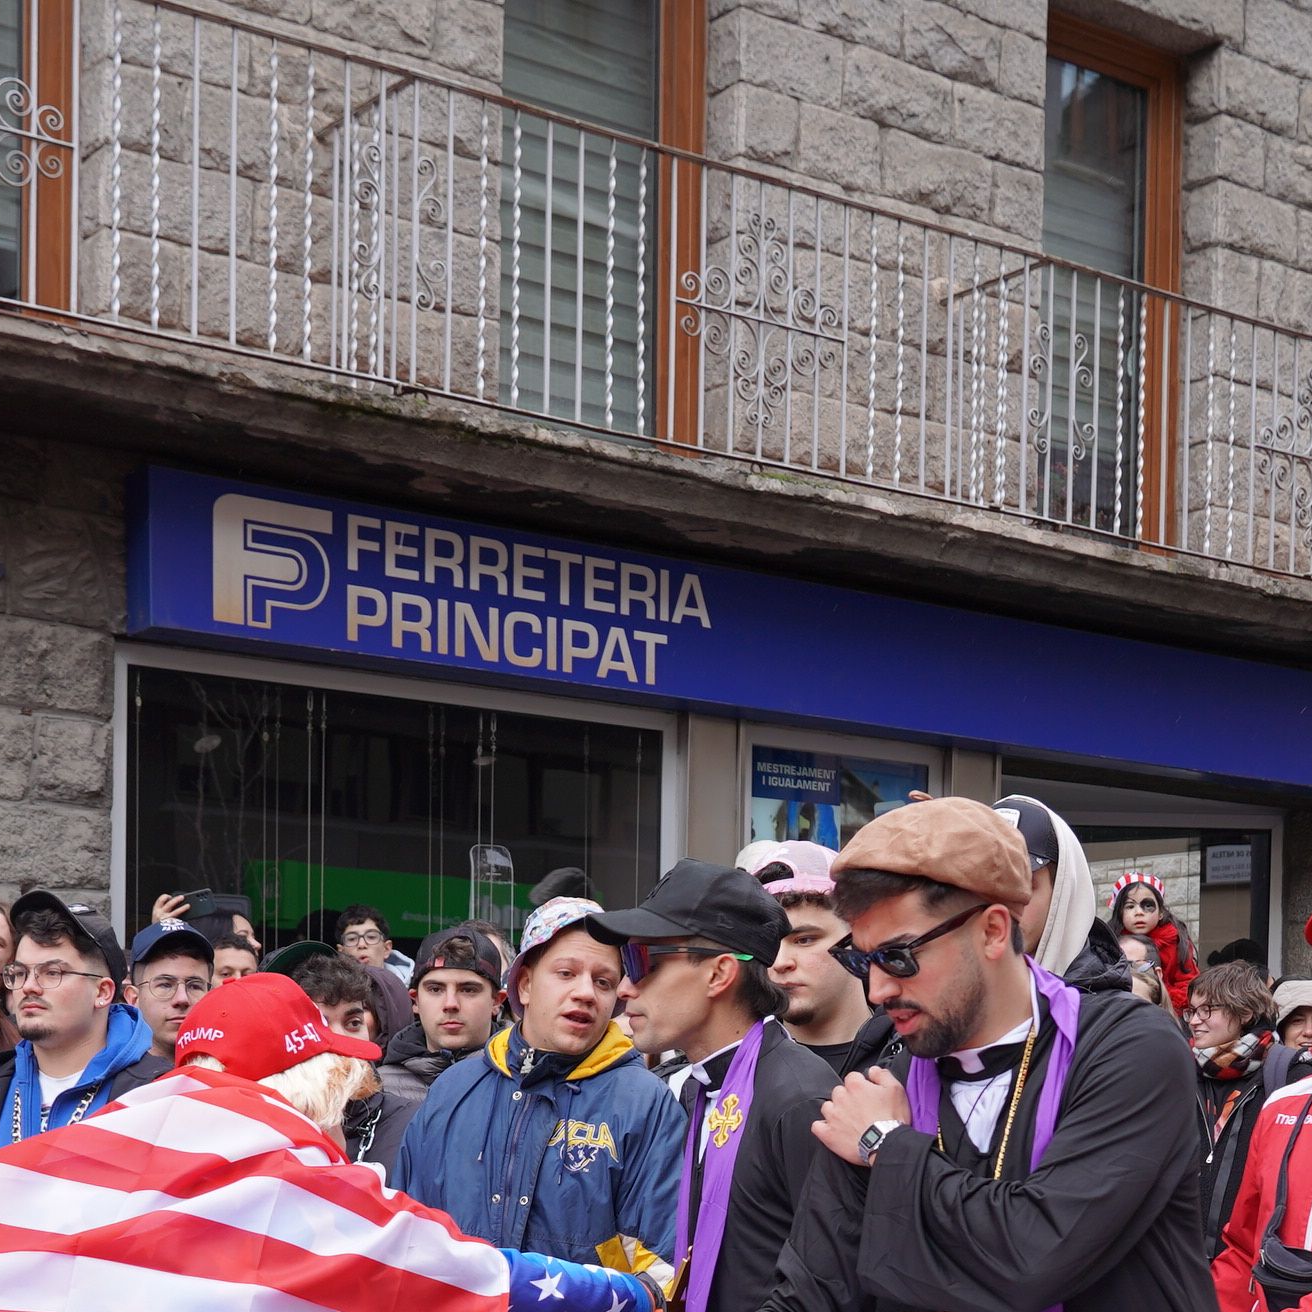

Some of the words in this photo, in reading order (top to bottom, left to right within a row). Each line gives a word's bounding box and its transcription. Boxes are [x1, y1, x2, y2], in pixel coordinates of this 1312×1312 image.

[347, 513, 712, 629] FERRETERIA
[347, 584, 668, 685] PRINCIPAT
[756, 761, 837, 780] MESTREJAMENT
[768, 776, 832, 792] IGUALAMENT
[177, 1027, 224, 1049] TRUMP
[284, 1022, 321, 1054] 45-47
